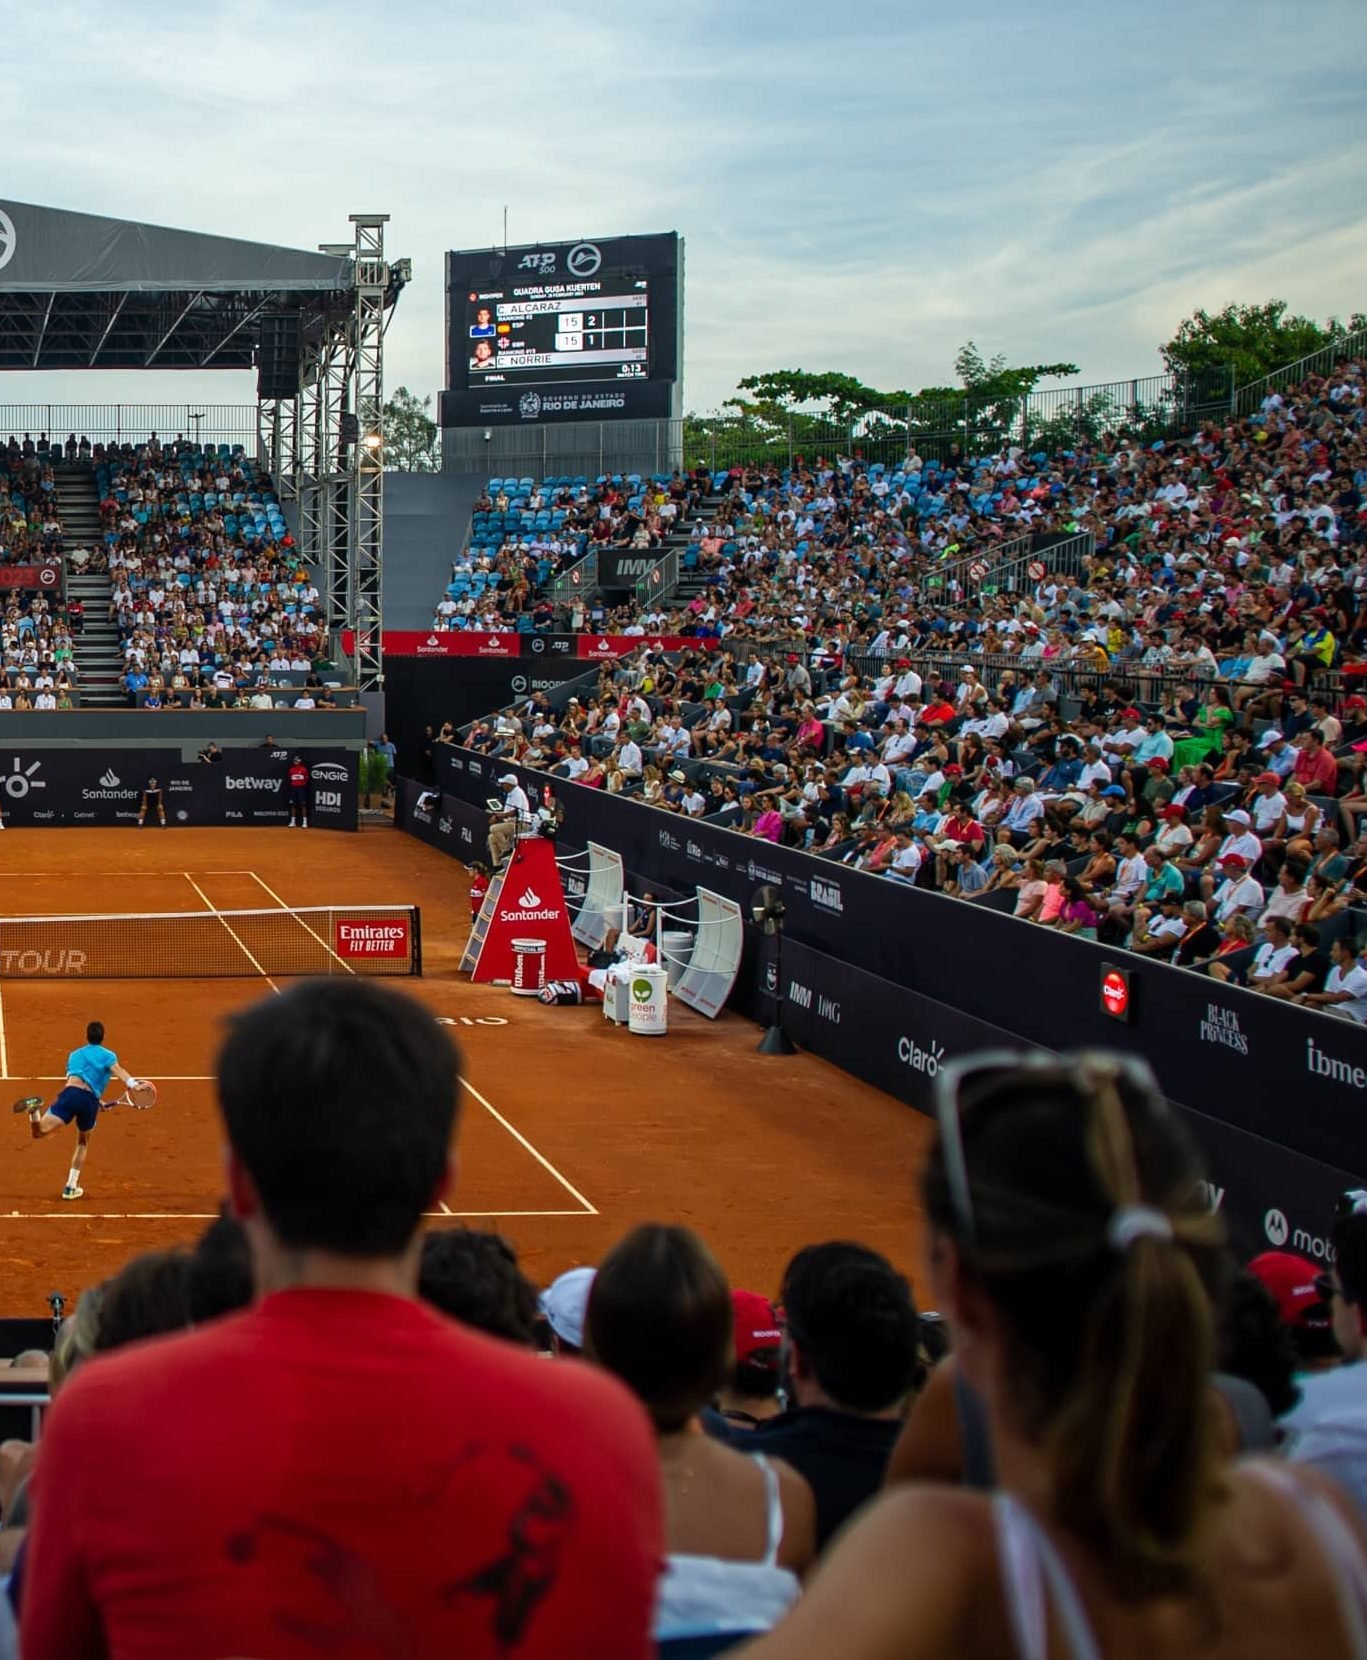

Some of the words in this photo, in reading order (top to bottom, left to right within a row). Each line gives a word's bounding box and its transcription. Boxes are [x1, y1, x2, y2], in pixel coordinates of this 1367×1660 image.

[518, 252, 557, 270] ATP
[510, 301, 562, 314] ALCARAZ
[564, 315, 578, 327] 15
[588, 315, 596, 326] 2
[564, 337, 578, 346] 15
[588, 334, 594, 346] 1
[510, 354, 552, 365] NORRIE
[484, 374, 506, 383] FINAL
[542, 401, 562, 411] RIO
[563, 400, 577, 410] DE
[578, 398, 625, 410] JANEIRO
[225, 776, 283, 793] betway
[82, 788, 139, 800] Santander
[315, 791, 342, 807] HDI
[500, 909, 560, 922] Santander
[340, 924, 405, 940] Emirates
[349, 939, 364, 952] FLY
[365, 939, 395, 952] BETTER
[514, 954, 524, 988] Wilson
[789, 980, 812, 1009] IMM
[817, 994, 841, 1025] IMG
[1207, 1003, 1240, 1032] BLACK
[898, 1036, 940, 1078] Claro
